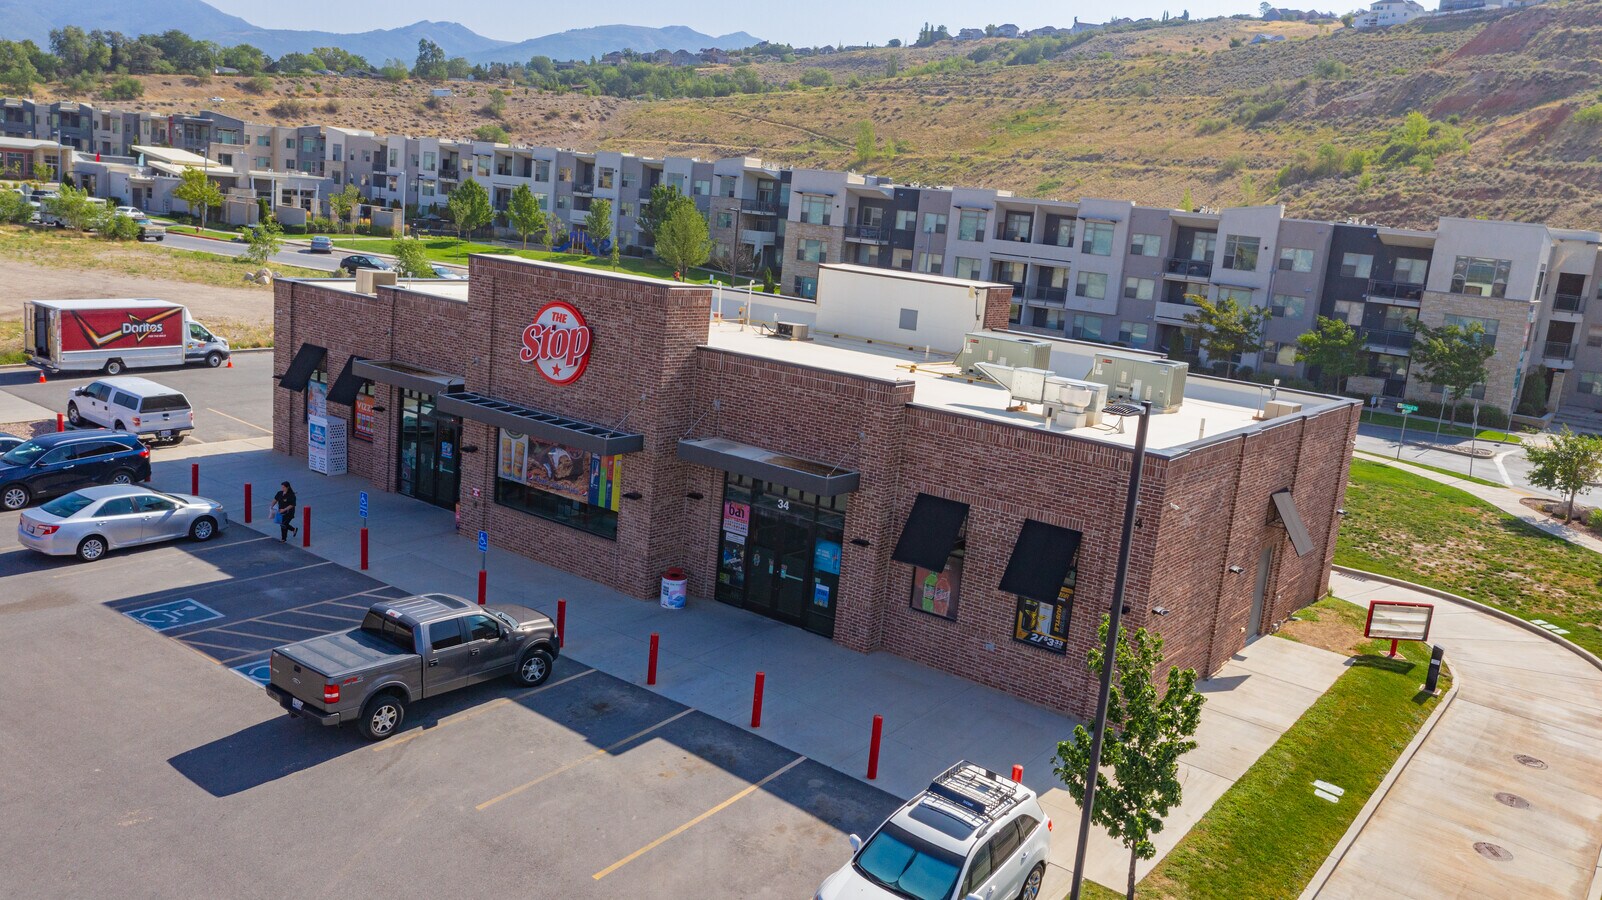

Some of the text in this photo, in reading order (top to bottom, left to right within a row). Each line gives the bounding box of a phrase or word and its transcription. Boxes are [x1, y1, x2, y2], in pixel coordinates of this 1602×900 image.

[551, 311, 568, 324] THE
[122, 322, 163, 334] Doritos
[520, 323, 590, 368] Stop
[728, 502, 745, 519] bai
[777, 498, 790, 511] 34
